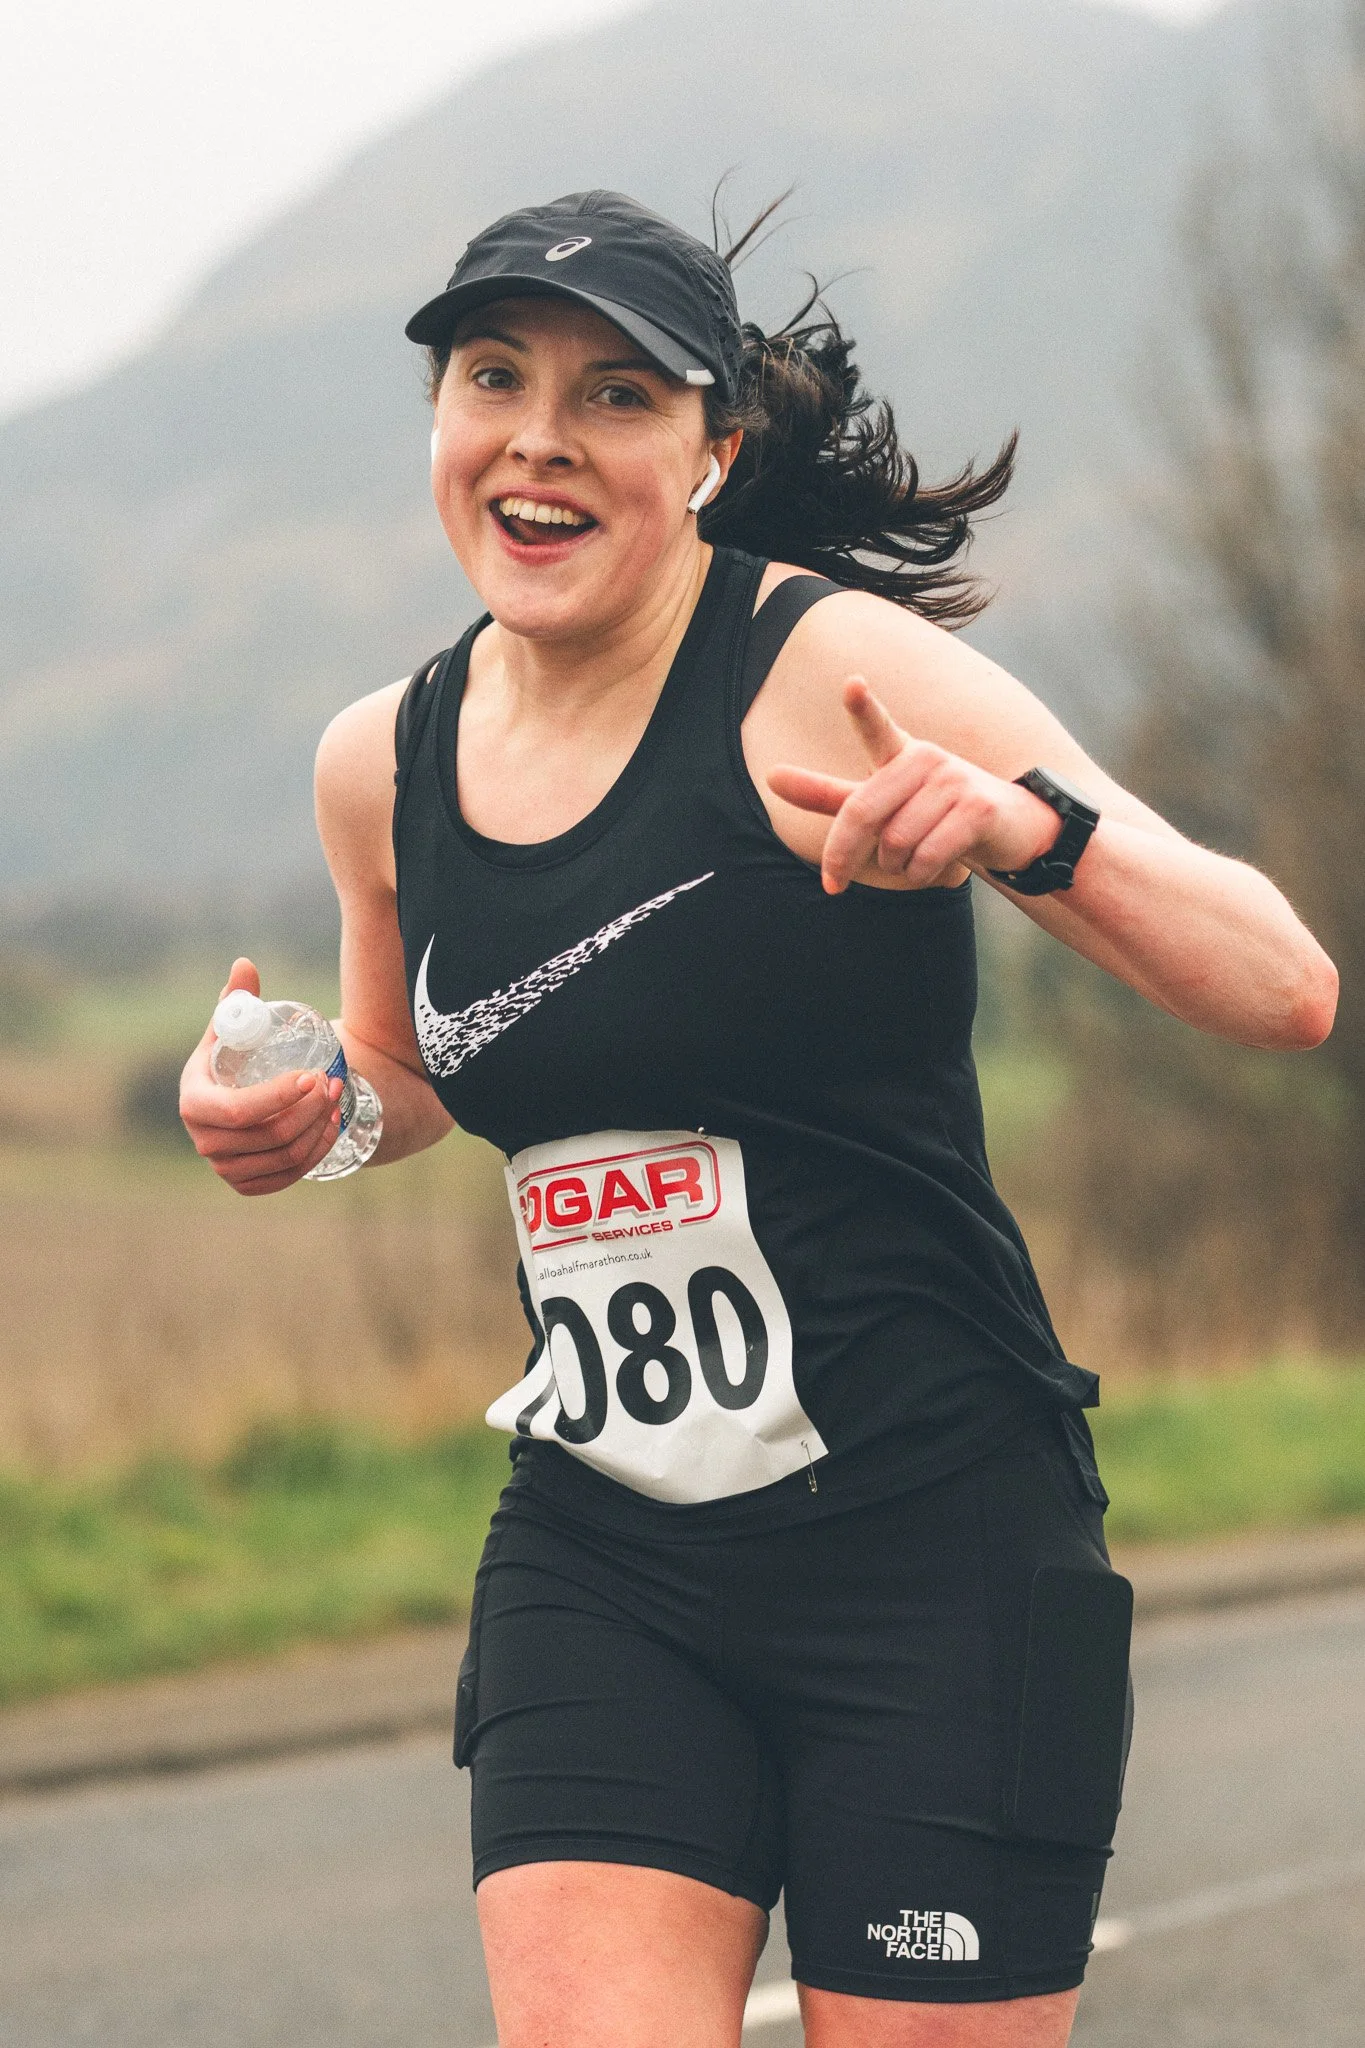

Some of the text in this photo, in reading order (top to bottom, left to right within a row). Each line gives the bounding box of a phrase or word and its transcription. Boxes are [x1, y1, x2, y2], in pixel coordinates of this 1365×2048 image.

[519, 1157, 704, 1234] OGAR
[591, 1220, 674, 1242] SERVICES
[899, 1909, 943, 1928] THE
[867, 1923, 942, 1944] NORTH
[886, 1941, 941, 1960] FACE
